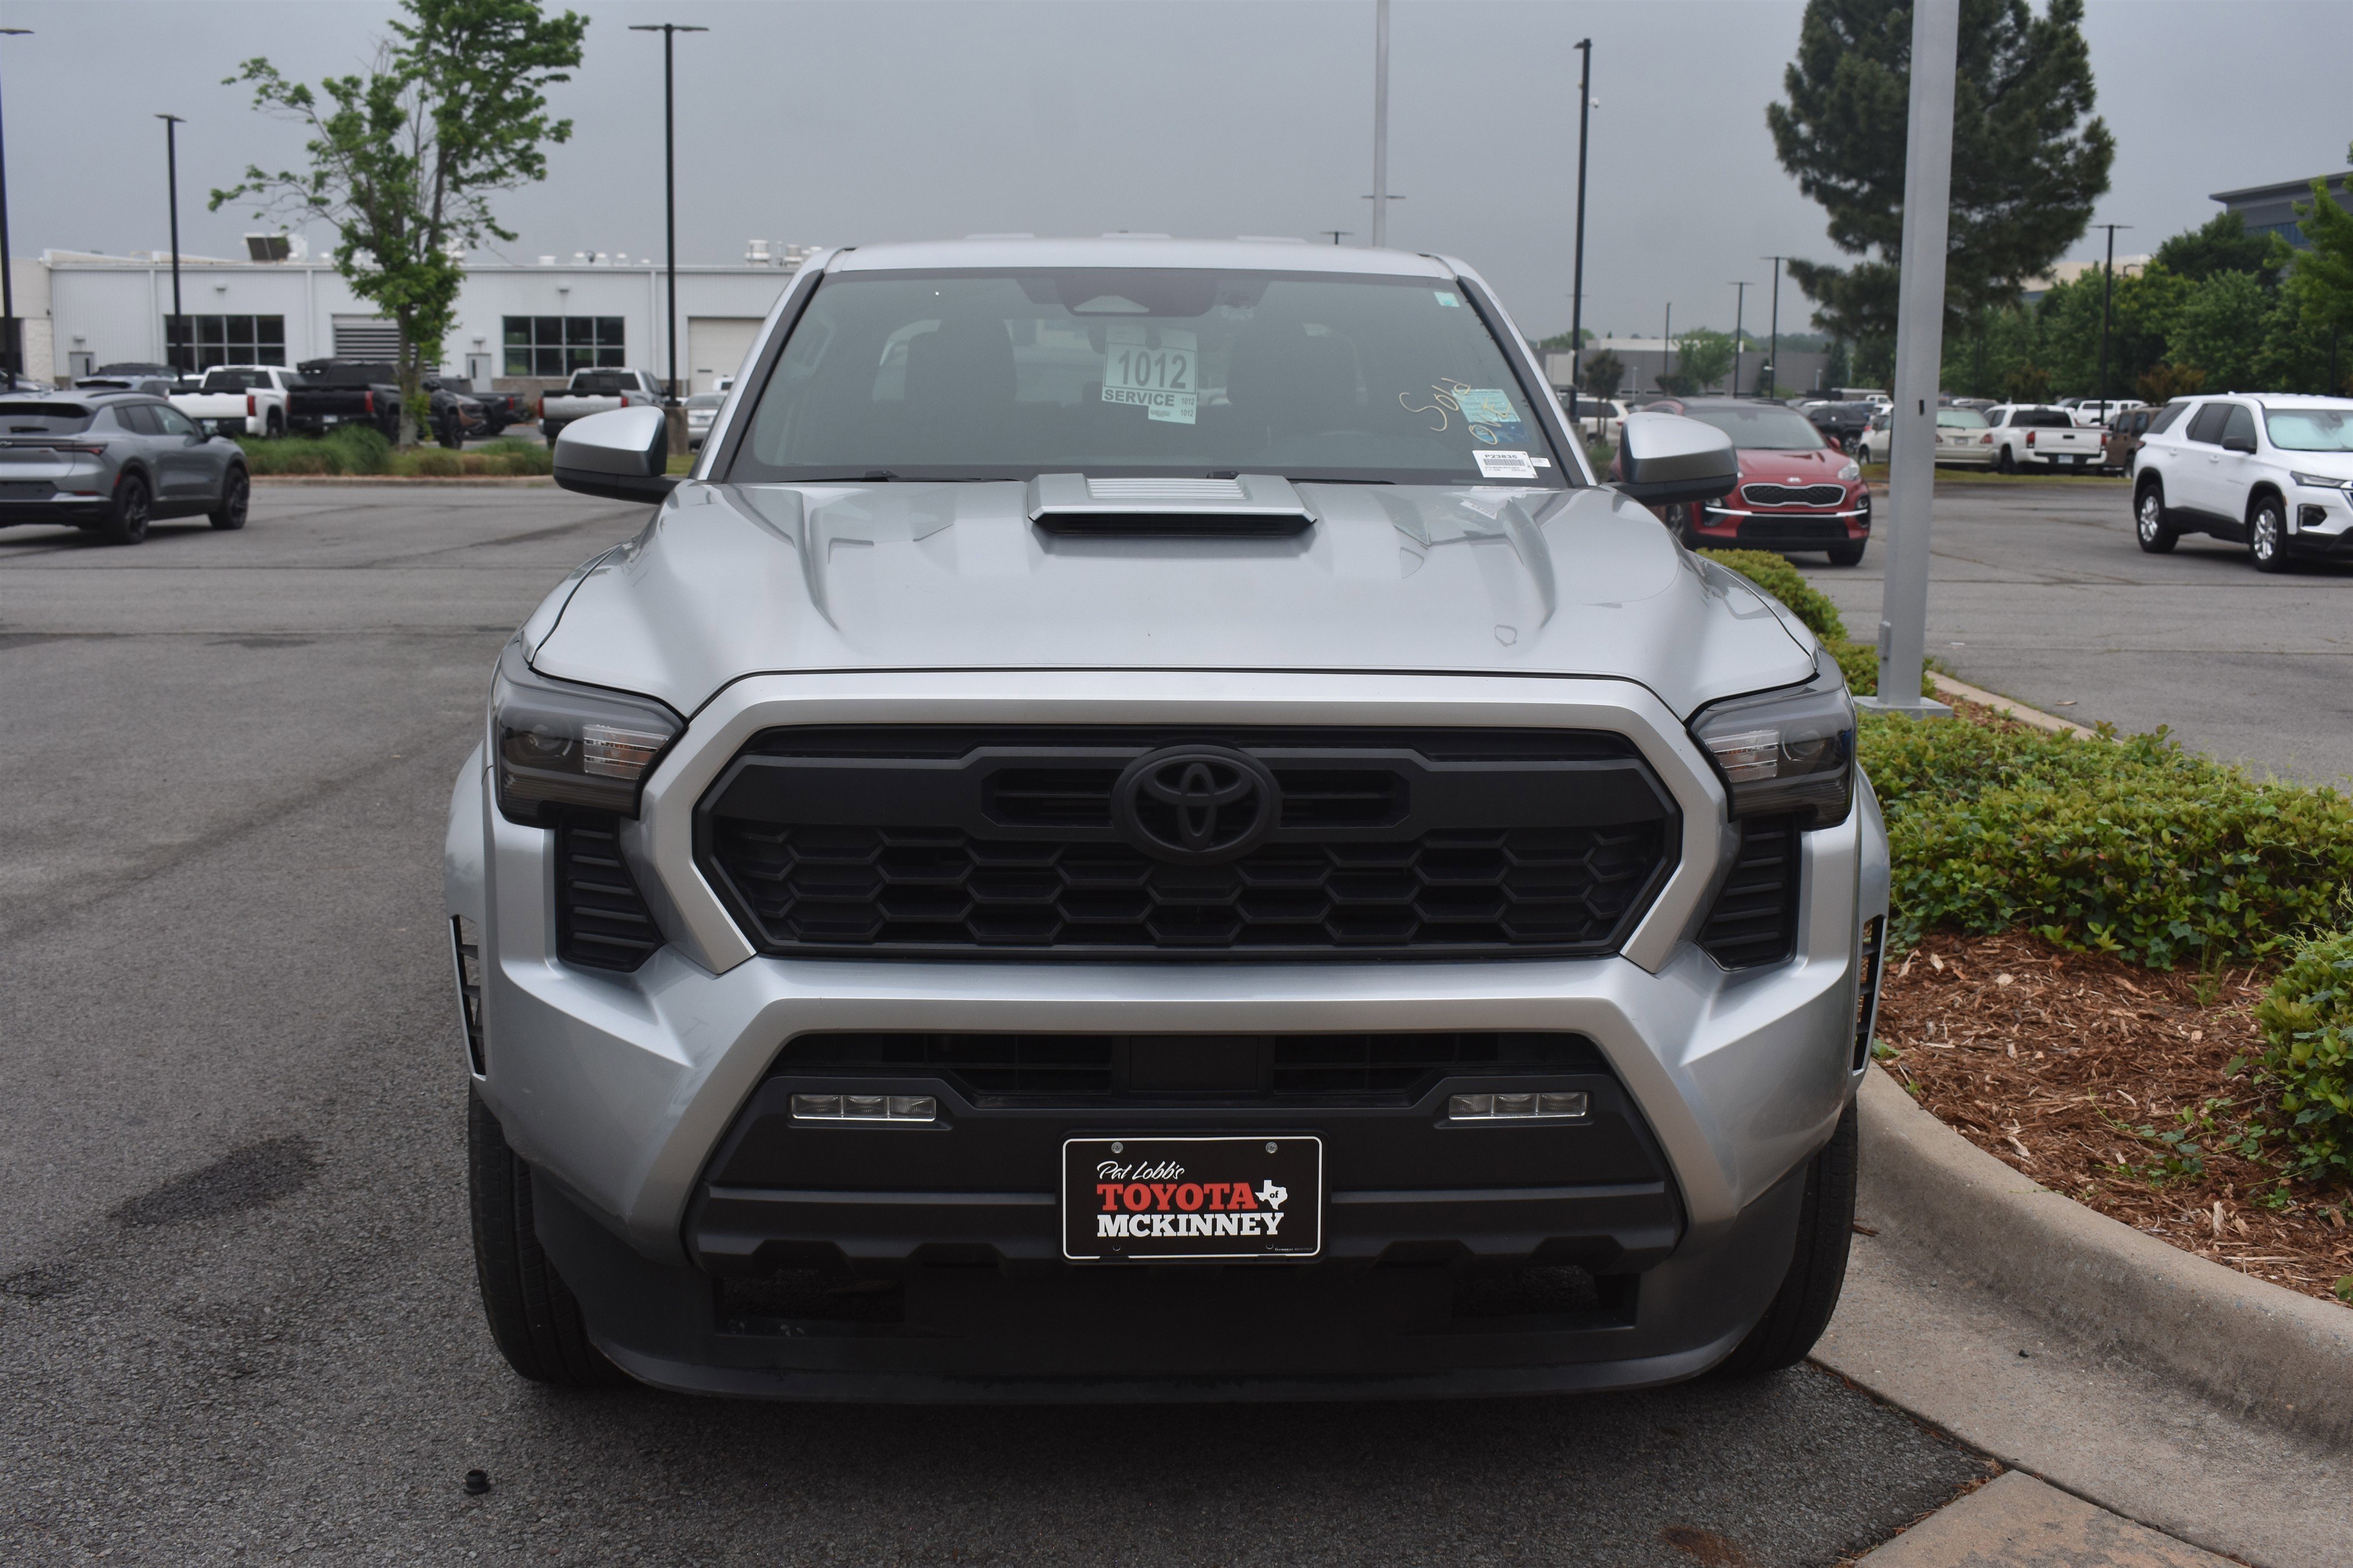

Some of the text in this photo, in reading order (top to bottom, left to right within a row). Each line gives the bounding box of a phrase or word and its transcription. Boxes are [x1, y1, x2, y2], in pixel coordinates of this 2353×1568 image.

[1118, 350, 1187, 389] 1012
[1104, 389, 1175, 407] SERVICE
[1181, 409, 1194, 417] 1012
[1097, 1160, 1185, 1180] Pat Lobb's
[1096, 1182, 1279, 1211] TOYOTA of
[1097, 1212, 1284, 1237] MCKINNEY
